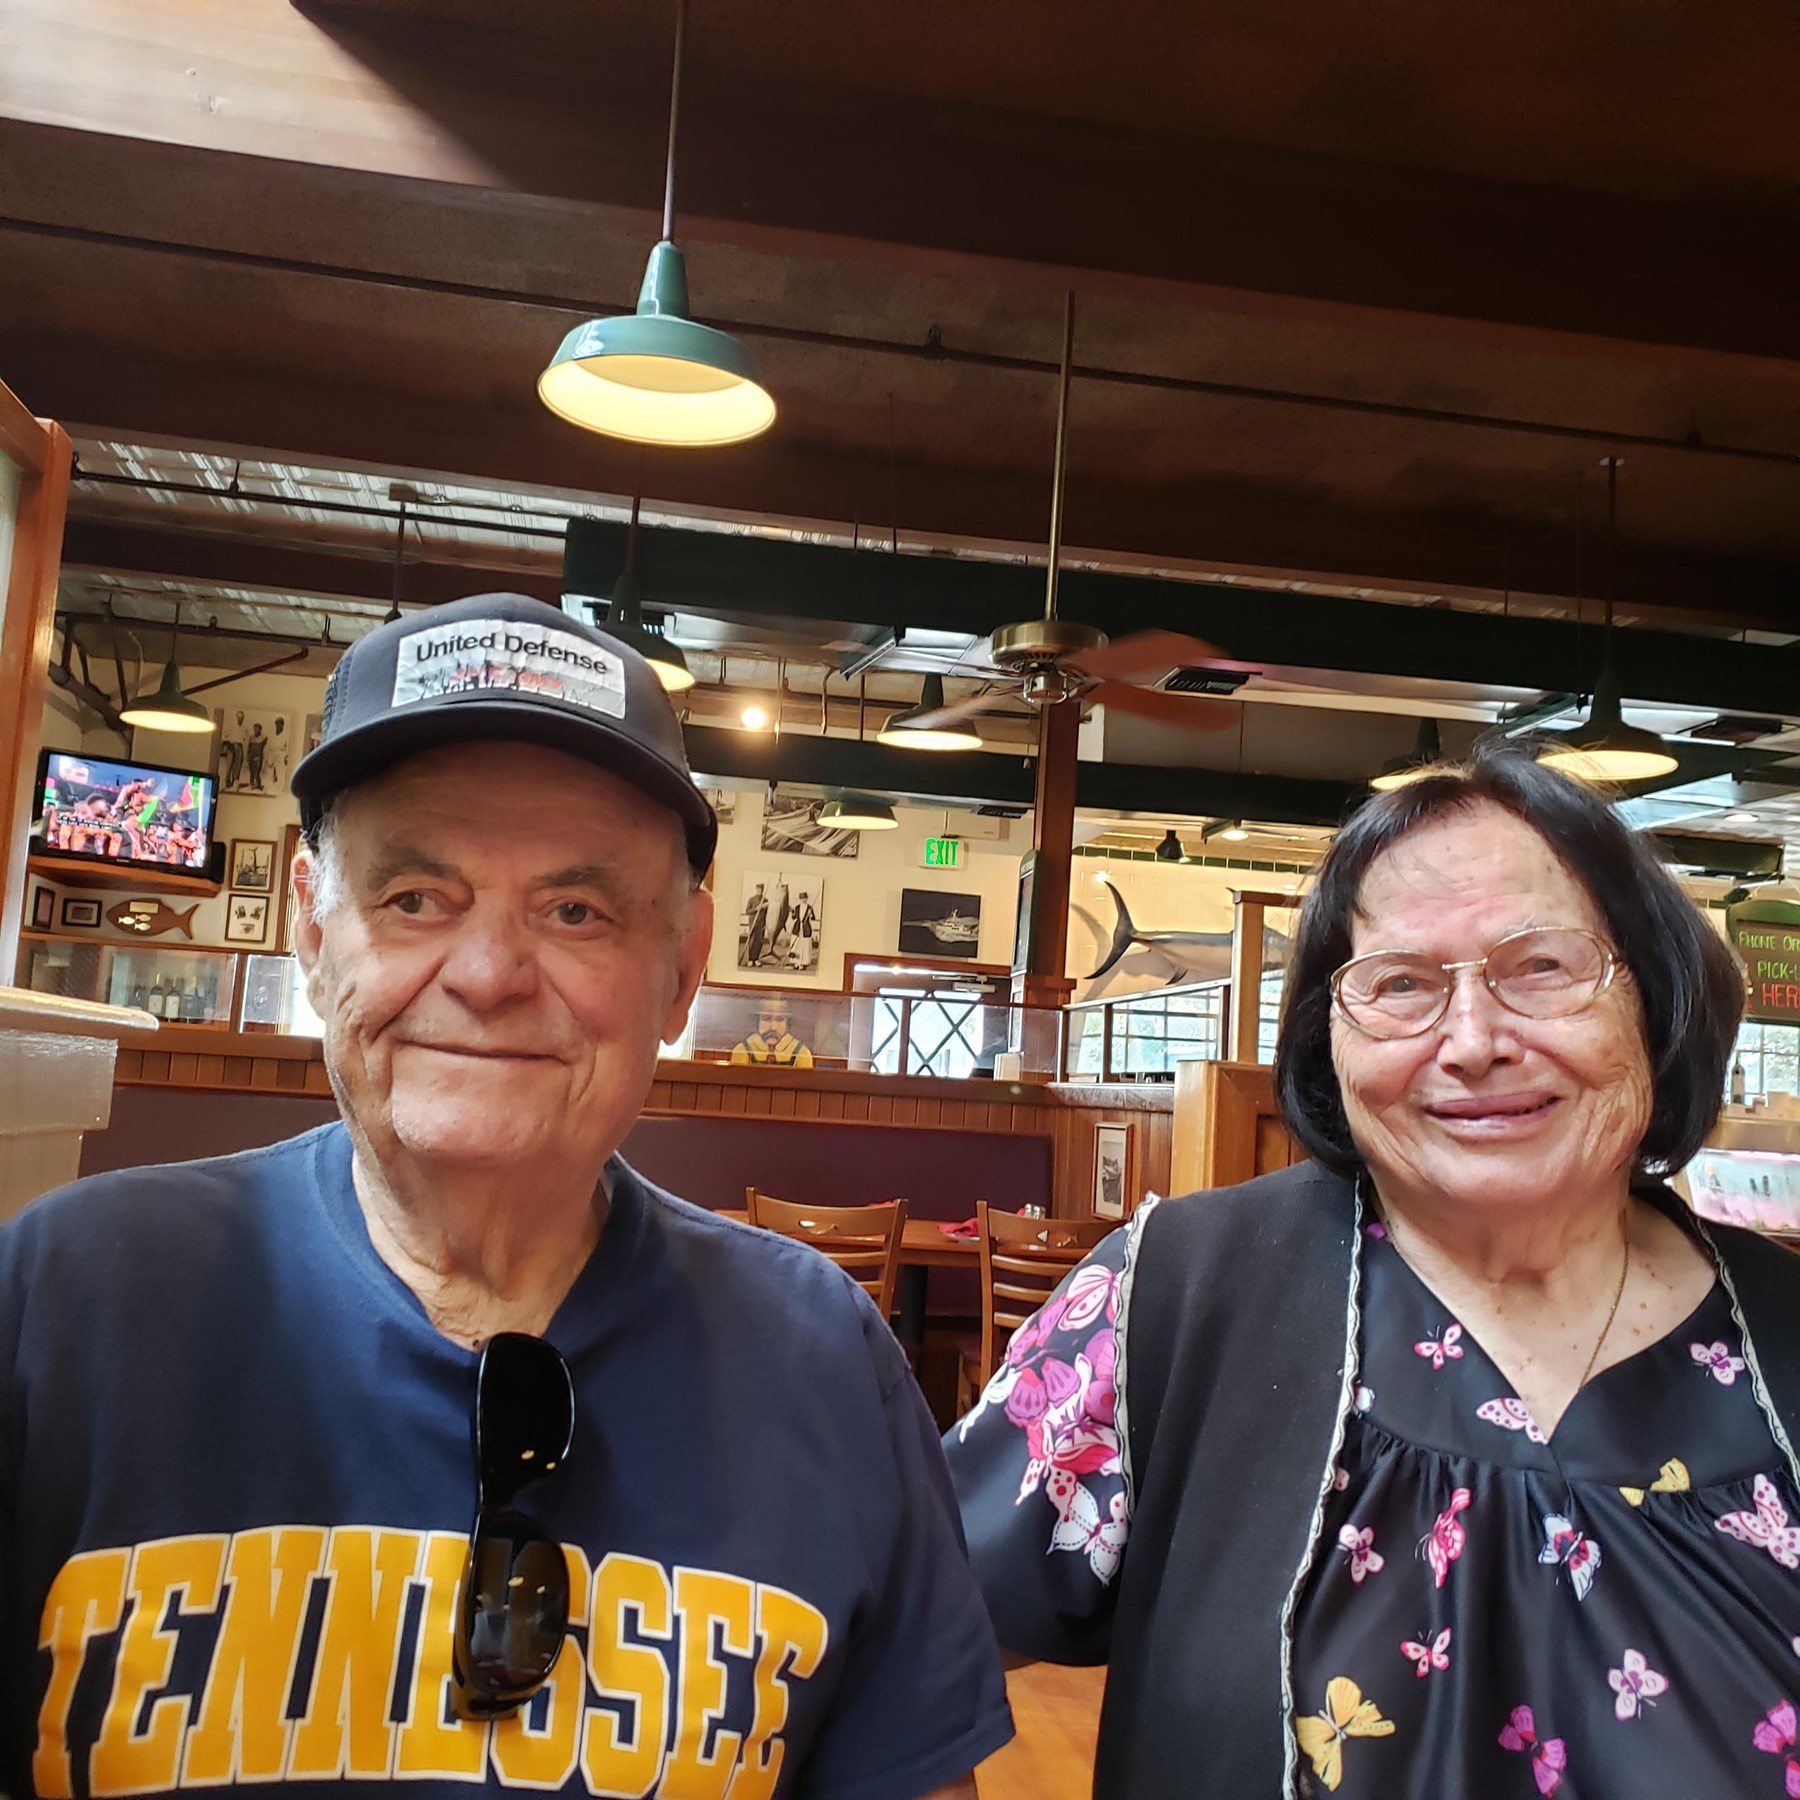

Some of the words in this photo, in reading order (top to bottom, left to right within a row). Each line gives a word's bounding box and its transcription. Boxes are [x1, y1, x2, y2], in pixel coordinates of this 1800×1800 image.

[416, 633, 498, 662] United
[503, 633, 607, 675] Defense
[925, 838, 959, 866] EXIT
